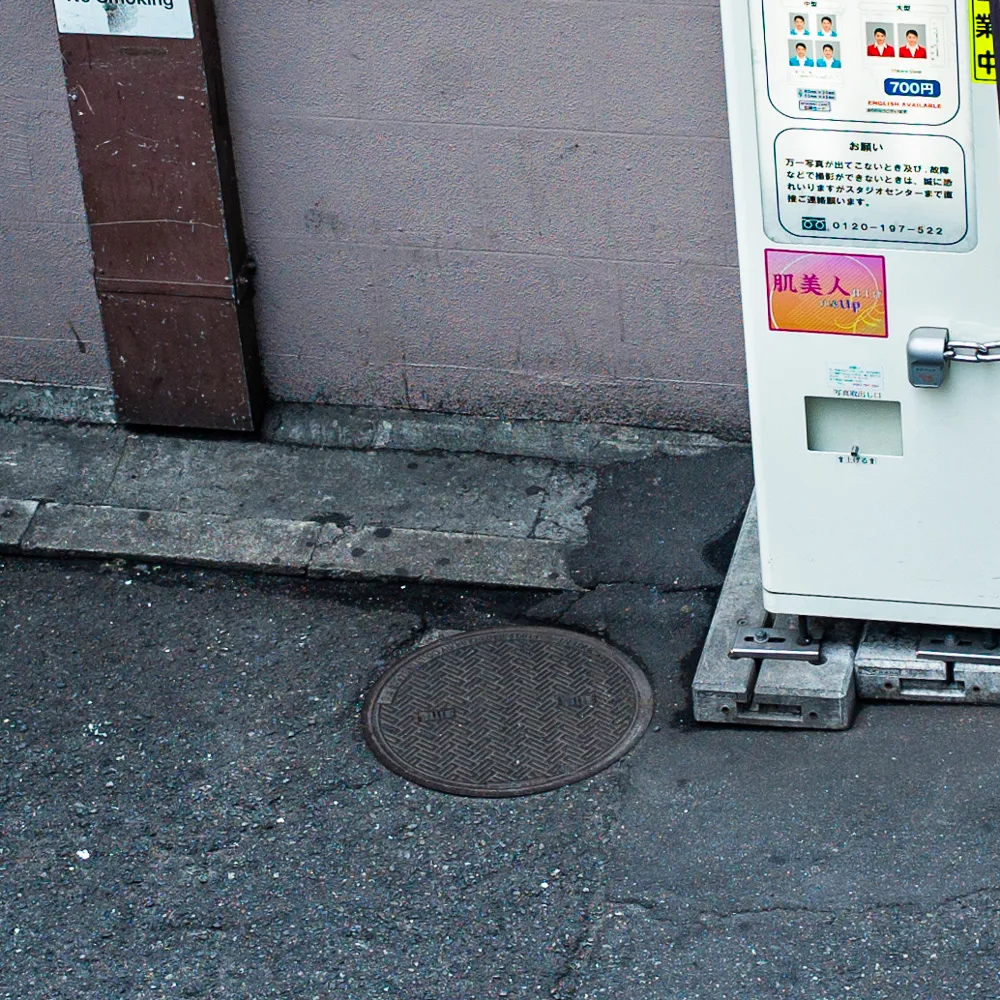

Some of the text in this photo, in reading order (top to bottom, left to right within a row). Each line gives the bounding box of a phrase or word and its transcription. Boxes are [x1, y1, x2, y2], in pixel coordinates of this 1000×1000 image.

[889, 81, 934, 95] 700円
[849, 141, 884, 153] お願い
[832, 221, 943, 236] 0120-197-522
[772, 273, 851, 297] 肌美人
